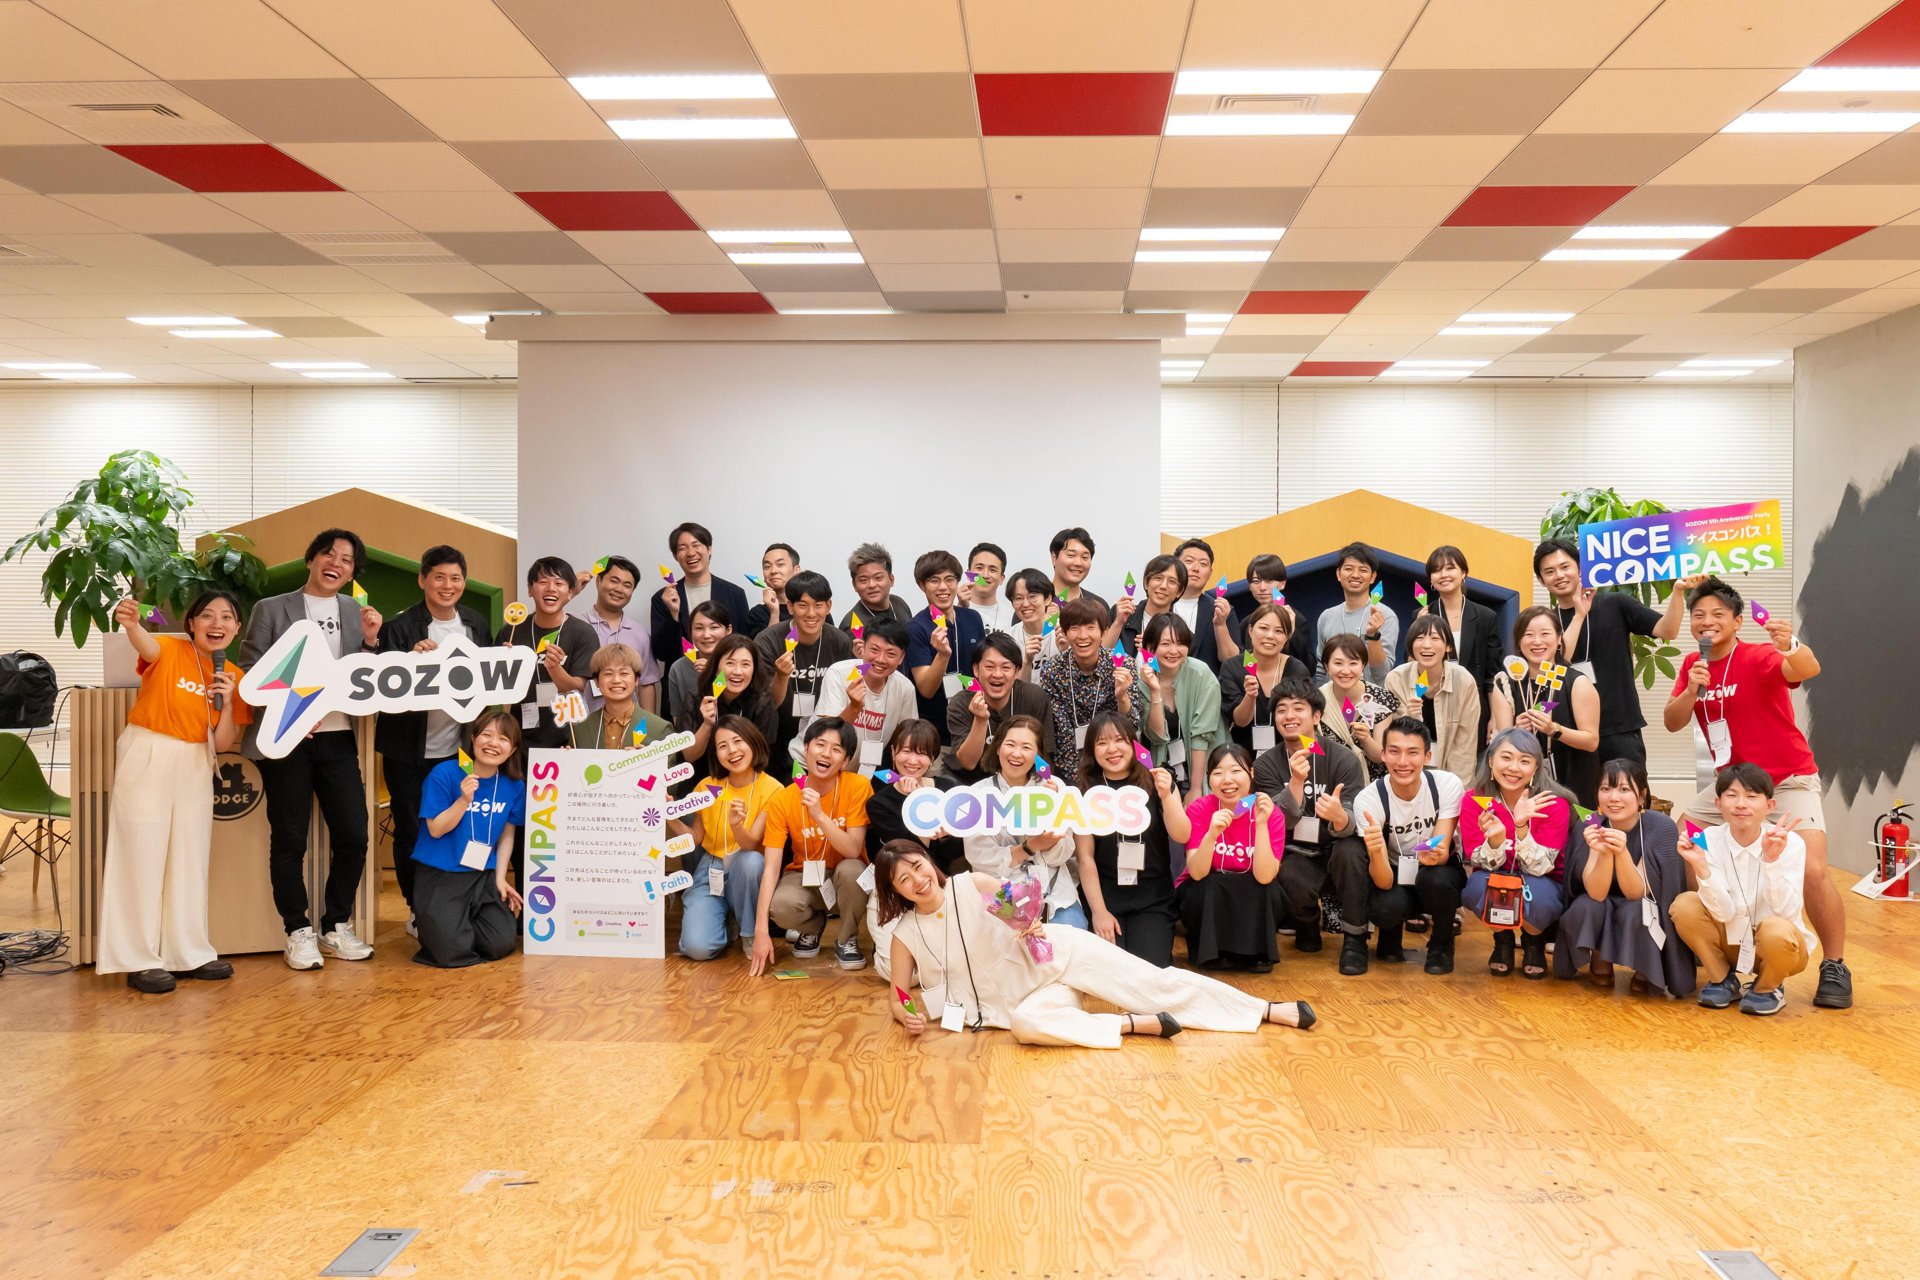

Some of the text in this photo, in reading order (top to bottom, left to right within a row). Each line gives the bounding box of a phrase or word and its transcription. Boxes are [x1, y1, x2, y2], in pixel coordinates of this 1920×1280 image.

[1685, 519, 1708, 527] SOZOW
[1719, 513, 1754, 523] Anniversary
[1754, 511, 1770, 519] Party
[1586, 524, 1671, 561] NICE
[1588, 544, 1776, 587] COMPASS
[348, 648, 523, 708] SOZOW
[790, 664, 828, 682] OZOW
[608, 734, 691, 772] Communication
[663, 766, 690, 782] Love
[666, 794, 711, 816] Creative
[908, 792, 1144, 831] COMPASS
[528, 761, 560, 942] COMPASS
[668, 839, 691, 854] Skill
[660, 875, 689, 891] Faith
